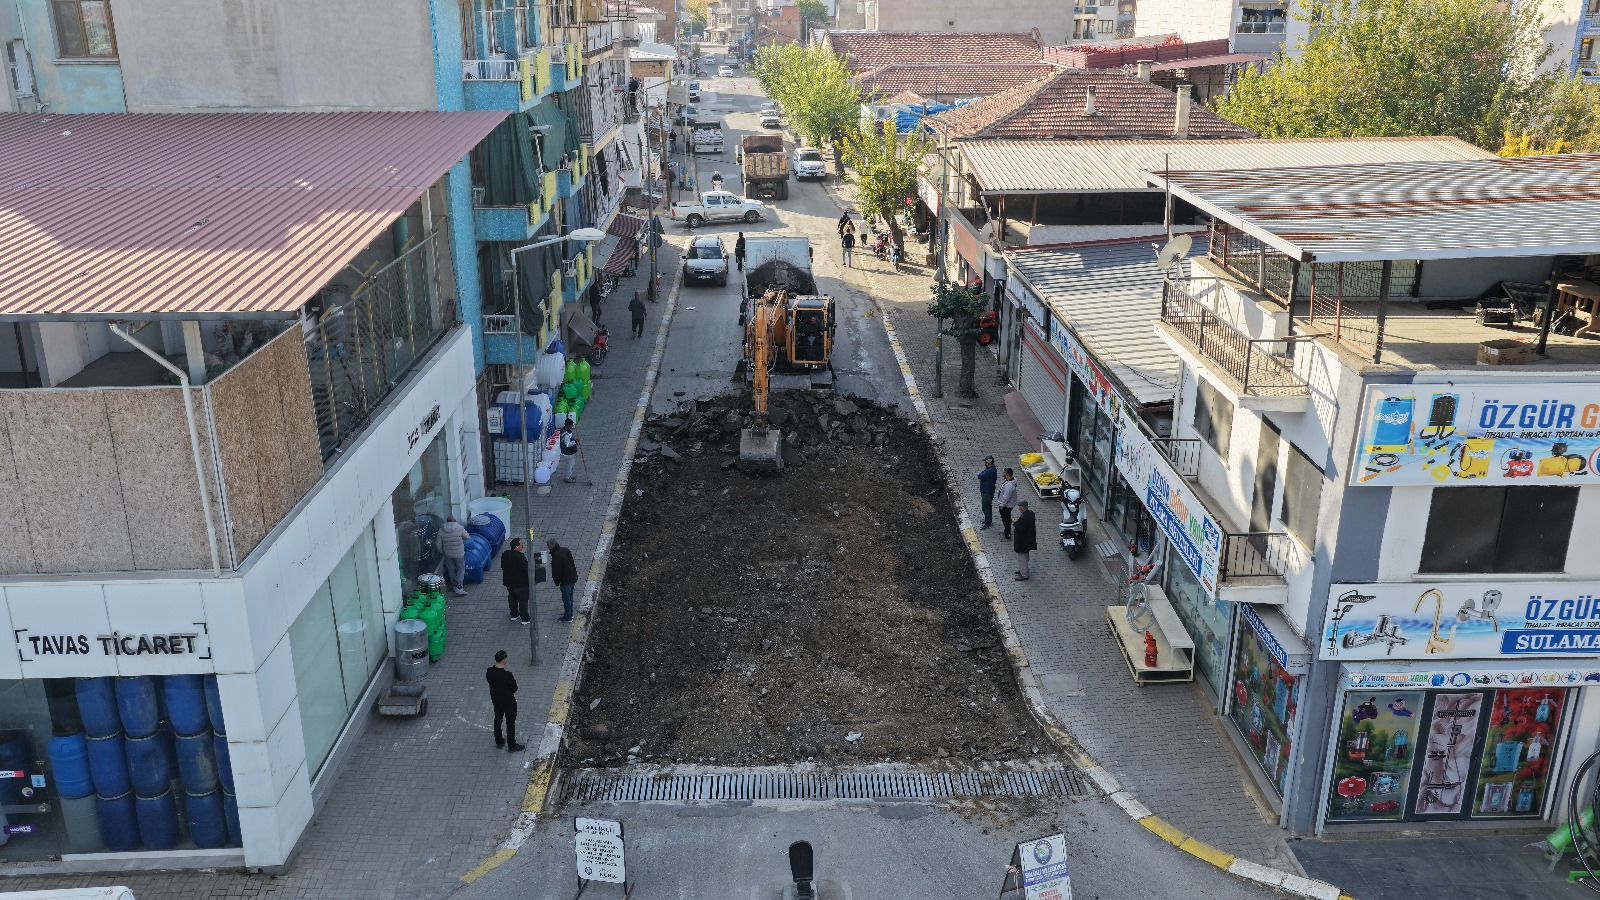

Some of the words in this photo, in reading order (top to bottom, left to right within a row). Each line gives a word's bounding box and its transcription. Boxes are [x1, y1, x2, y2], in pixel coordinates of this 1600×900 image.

[1479, 400, 1576, 429] ÖZGÜR
[1580, 404, 1600, 429] G
[1520, 430, 1552, 439] İHRACAT
[28, 634, 90, 655] TAVAS
[96, 630, 199, 656] TİCARET
[1515, 634, 1600, 650] SULAMA
